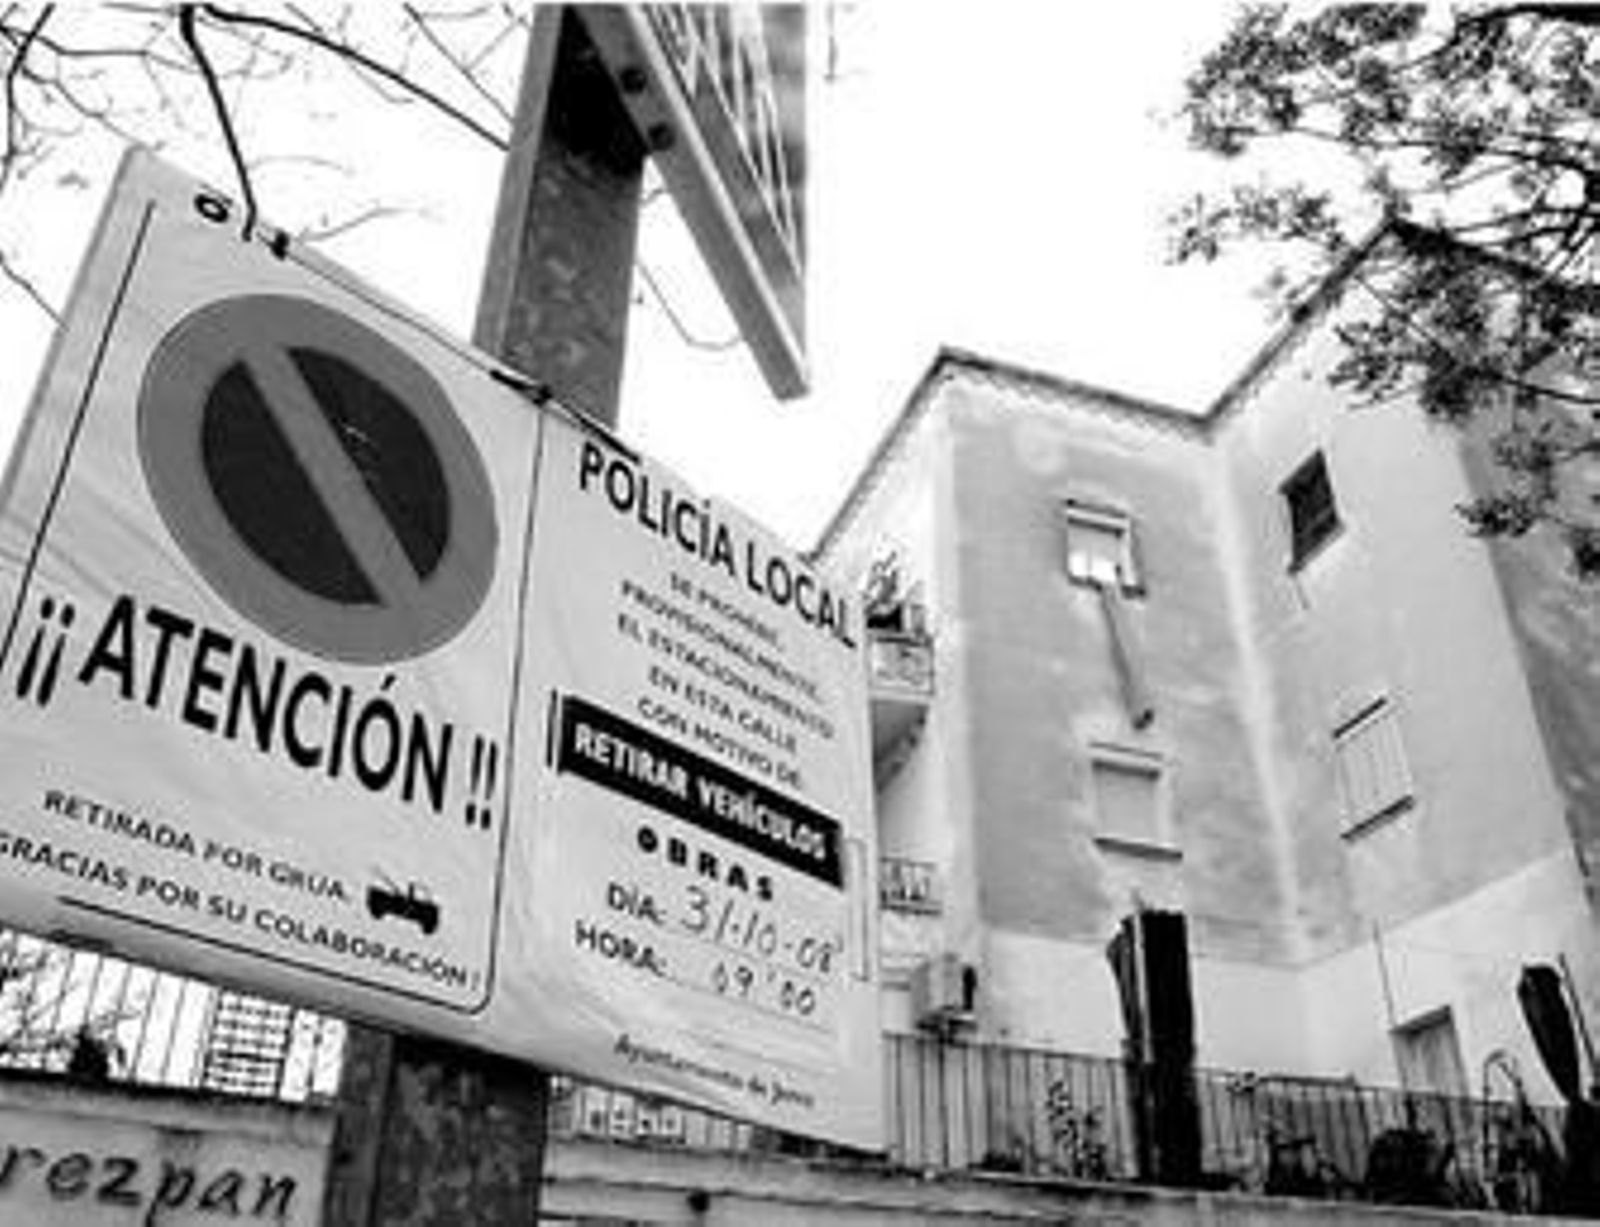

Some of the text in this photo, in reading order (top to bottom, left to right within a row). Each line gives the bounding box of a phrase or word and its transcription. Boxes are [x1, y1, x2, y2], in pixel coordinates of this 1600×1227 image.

[747, 541, 856, 649] LOCAL
[574, 722, 688, 799] RETIRAR
[45, 790, 196, 857] RETIRADA
[203, 840, 262, 878] POR
[136, 875, 200, 911] POR
[207, 895, 247, 923] SU
